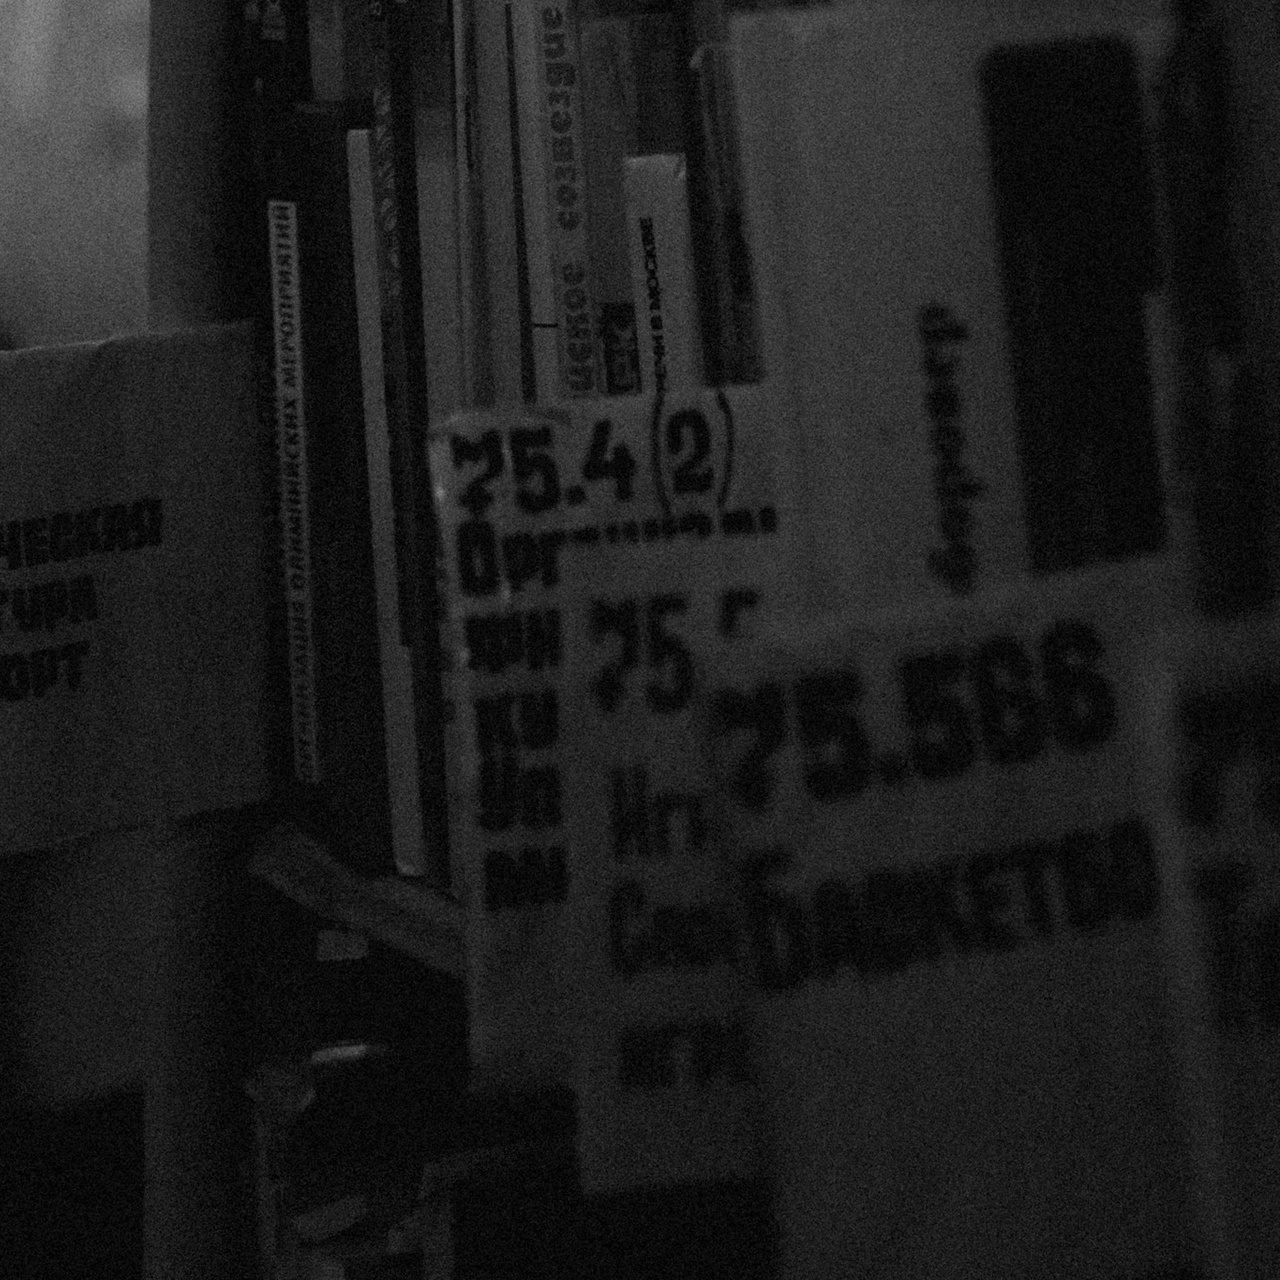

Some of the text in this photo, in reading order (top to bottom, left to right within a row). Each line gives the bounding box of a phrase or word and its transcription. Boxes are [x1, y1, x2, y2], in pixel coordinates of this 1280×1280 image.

[542, 6, 581, 231] созвездие
[273, 202, 298, 389] МЕРОПРИЯТИЙ
[638, 217, 662, 311] МОСКВЕ
[282, 394, 304, 592] ОЛИМПИЙСКИХ
[453, 390, 733, 516] 75.4(2)
